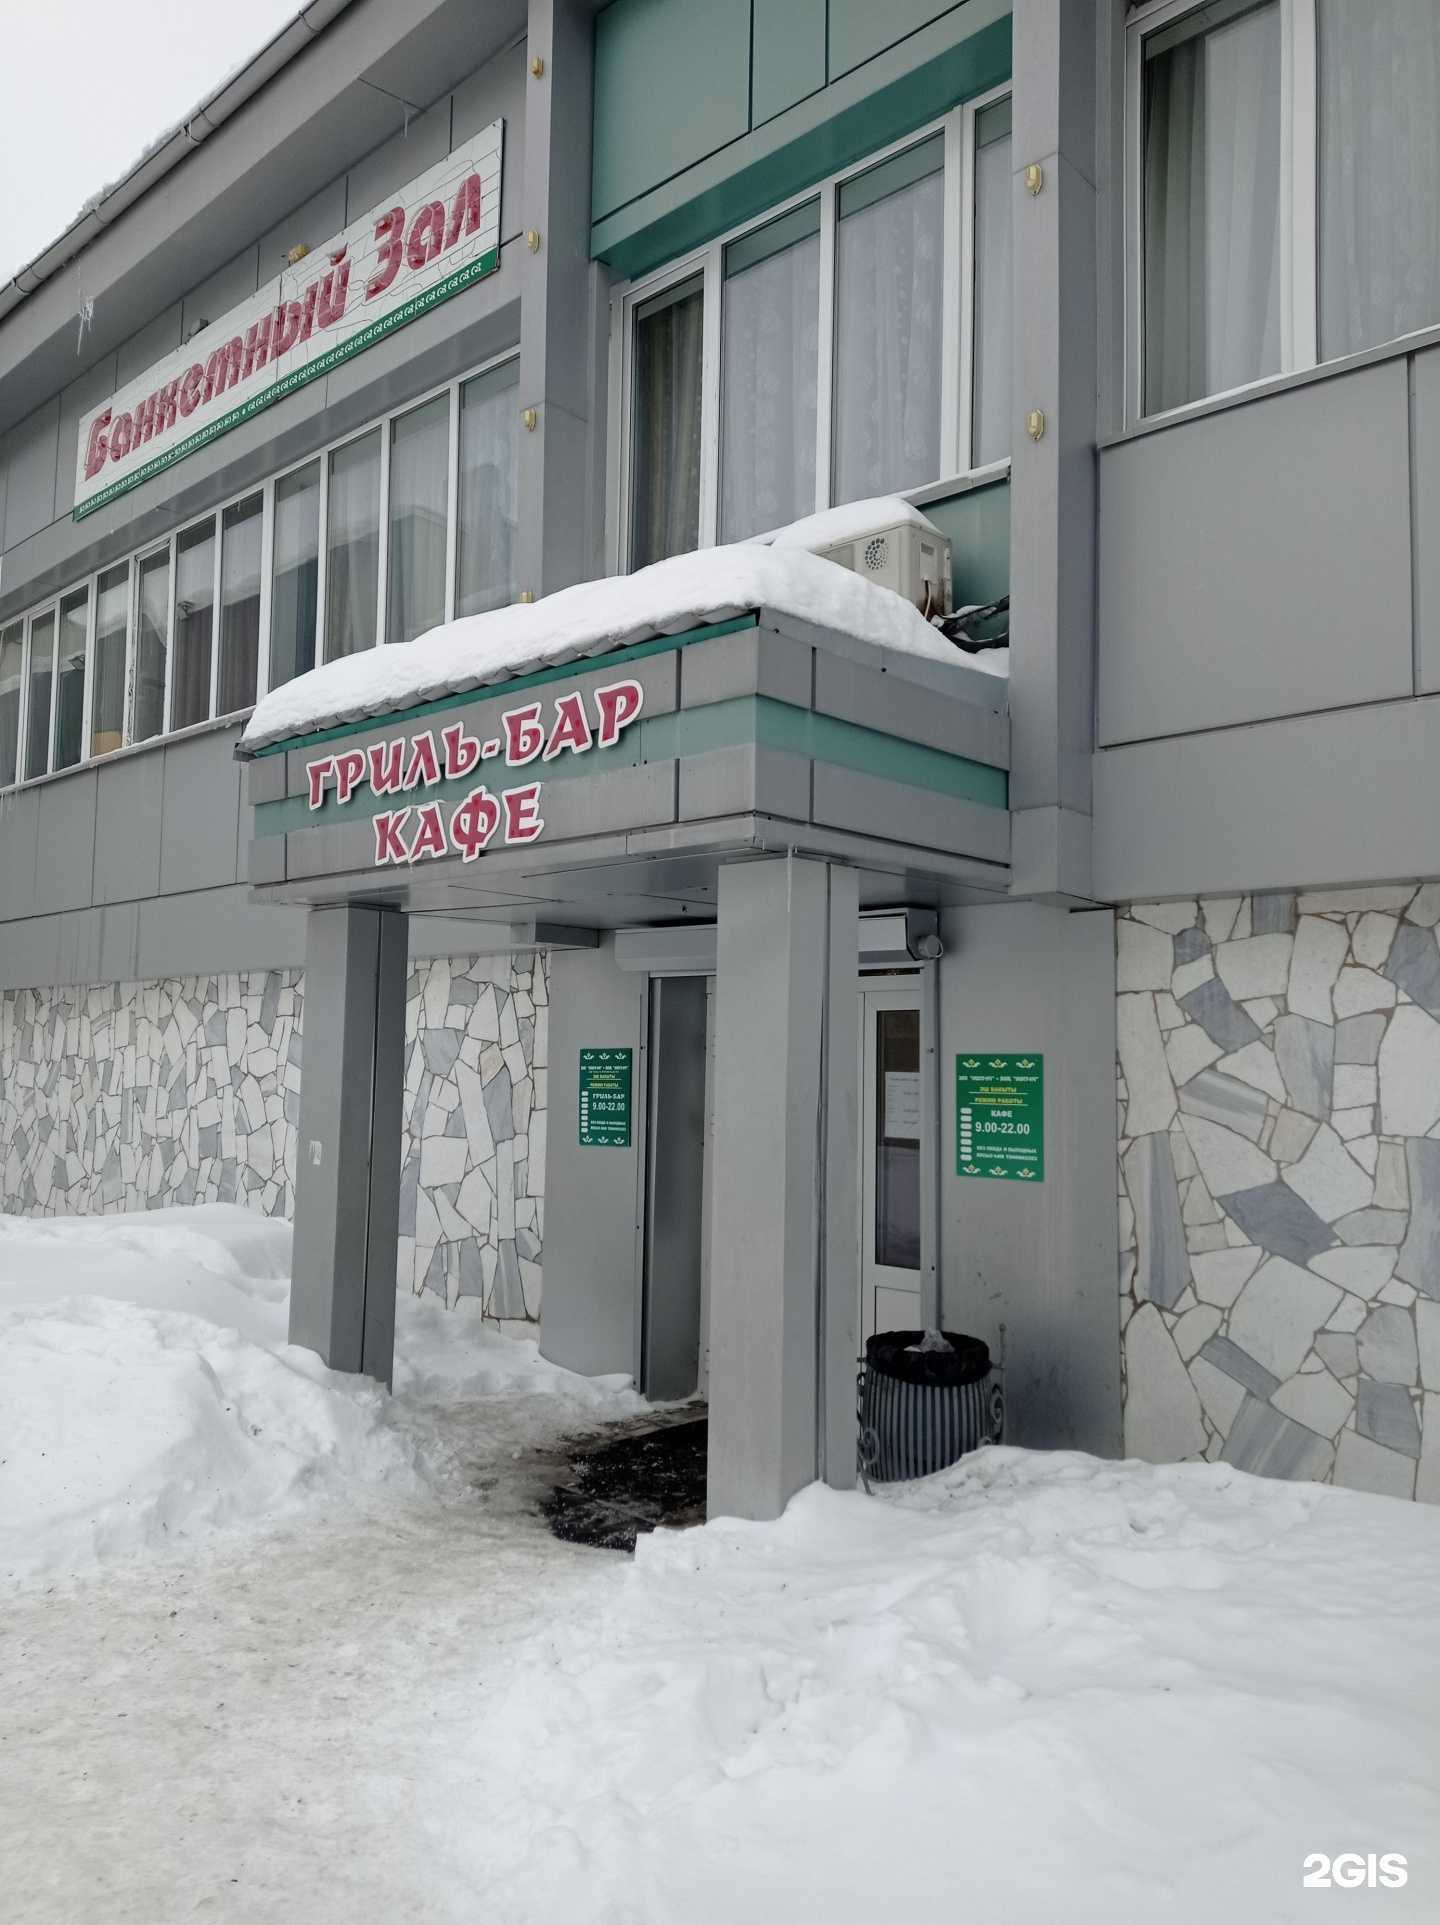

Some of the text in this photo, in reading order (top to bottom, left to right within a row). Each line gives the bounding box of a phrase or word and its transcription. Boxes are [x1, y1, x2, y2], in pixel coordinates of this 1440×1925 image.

[84, 172, 482, 482] Банкетный Зал
[307, 679, 644, 810] ГРИЛЬ-БАР
[373, 782, 544, 863] КАФЕ
[592, 1102, 625, 1111] 9.00-22.00
[975, 1121, 1031, 1135] 9.00-22.00
[990, 1110, 1013, 1118] КАФЕ
